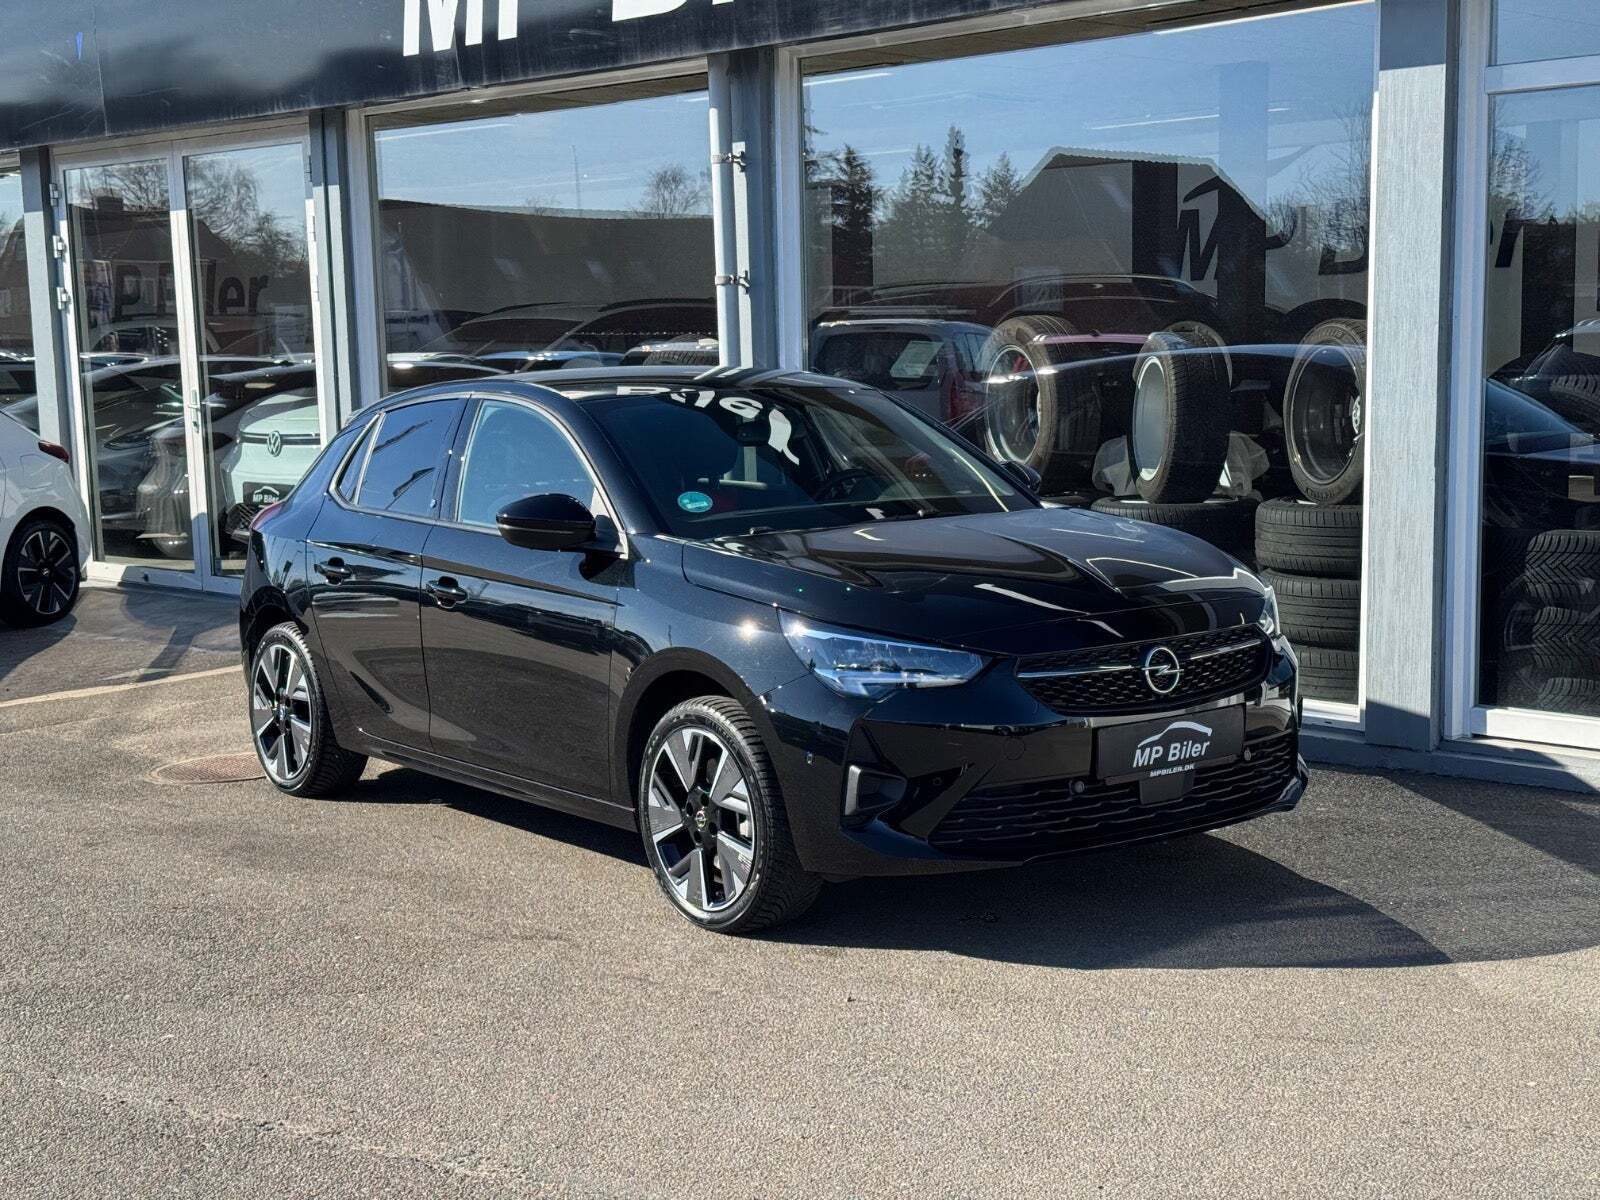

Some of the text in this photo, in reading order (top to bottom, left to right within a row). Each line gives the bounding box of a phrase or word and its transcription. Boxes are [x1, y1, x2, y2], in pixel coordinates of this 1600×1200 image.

[252, 493, 263, 503] MP
[1132, 740, 1210, 768] MP Biler
[1149, 764, 1195, 777] MPBILER.DK
